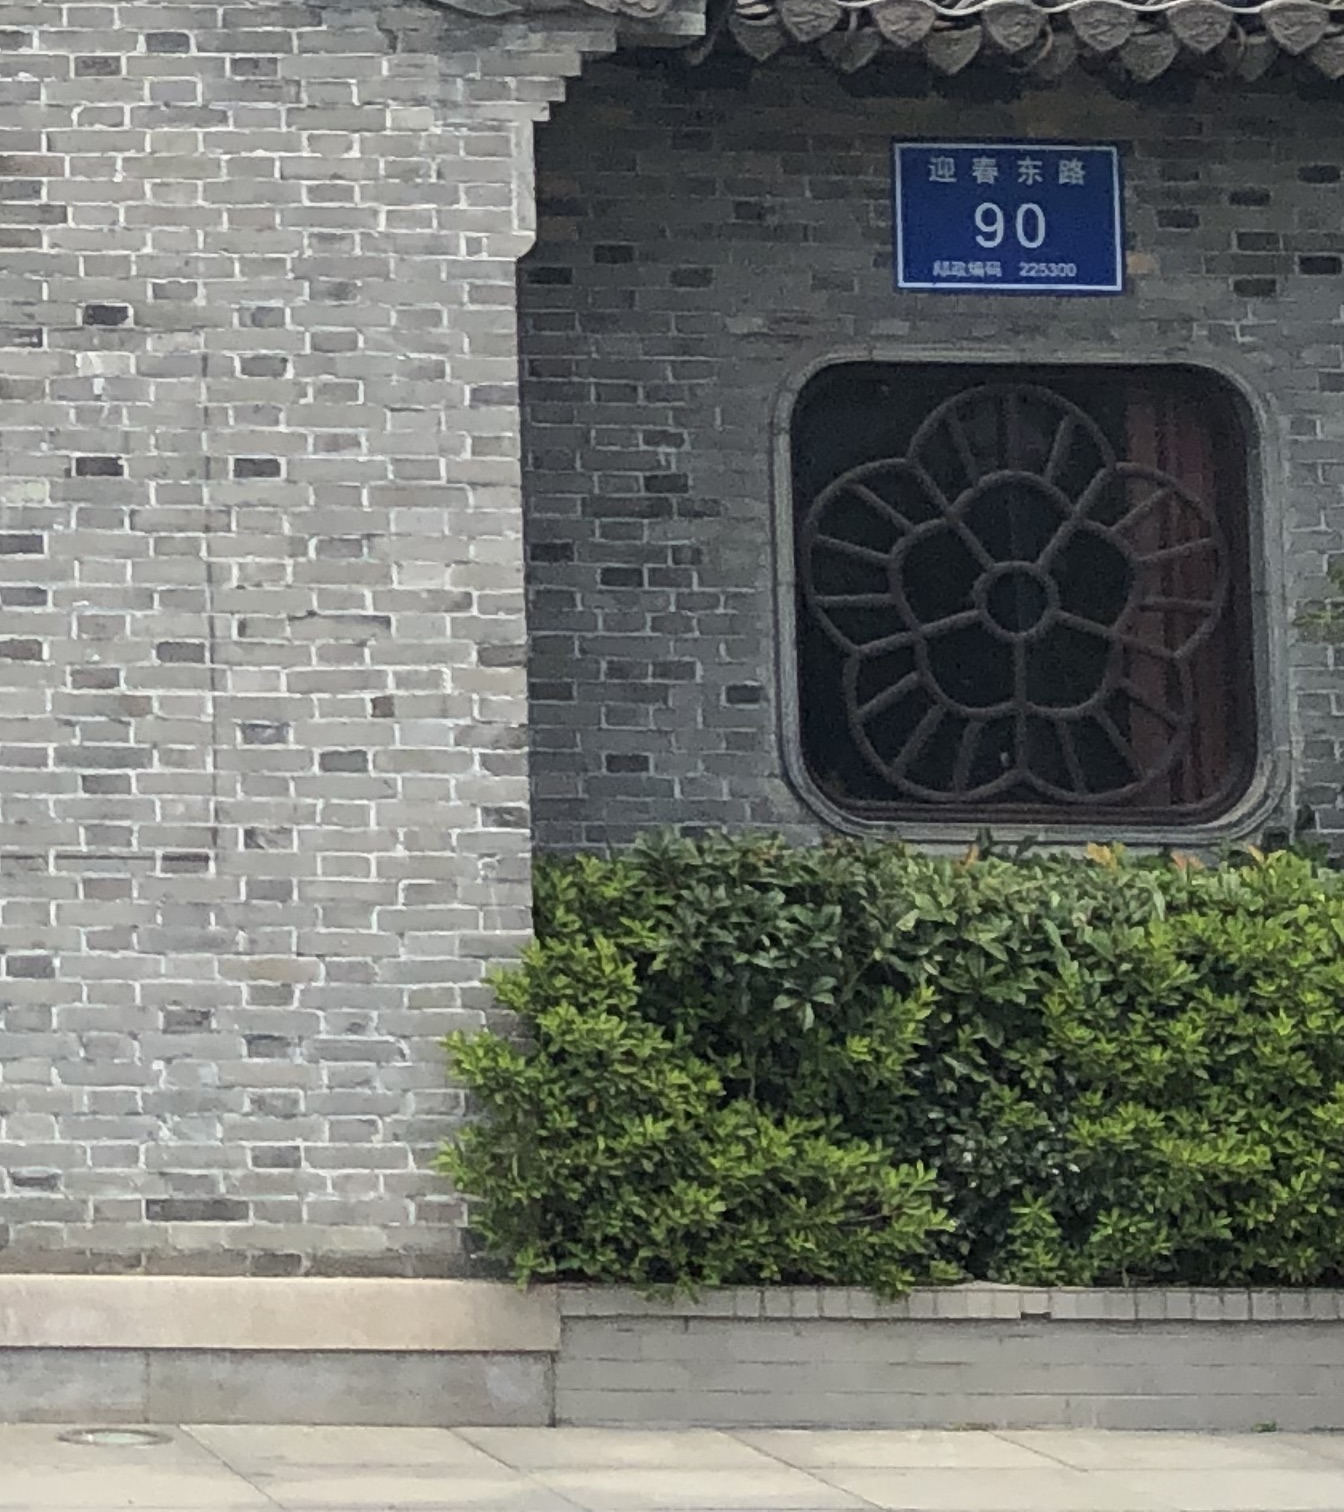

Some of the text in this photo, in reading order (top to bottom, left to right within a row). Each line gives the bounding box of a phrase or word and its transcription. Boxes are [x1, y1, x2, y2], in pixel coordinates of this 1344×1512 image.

[928, 155, 1087, 187] 迎春东路
[974, 201, 1047, 249] 90
[1018, 261, 1078, 278] 225300
